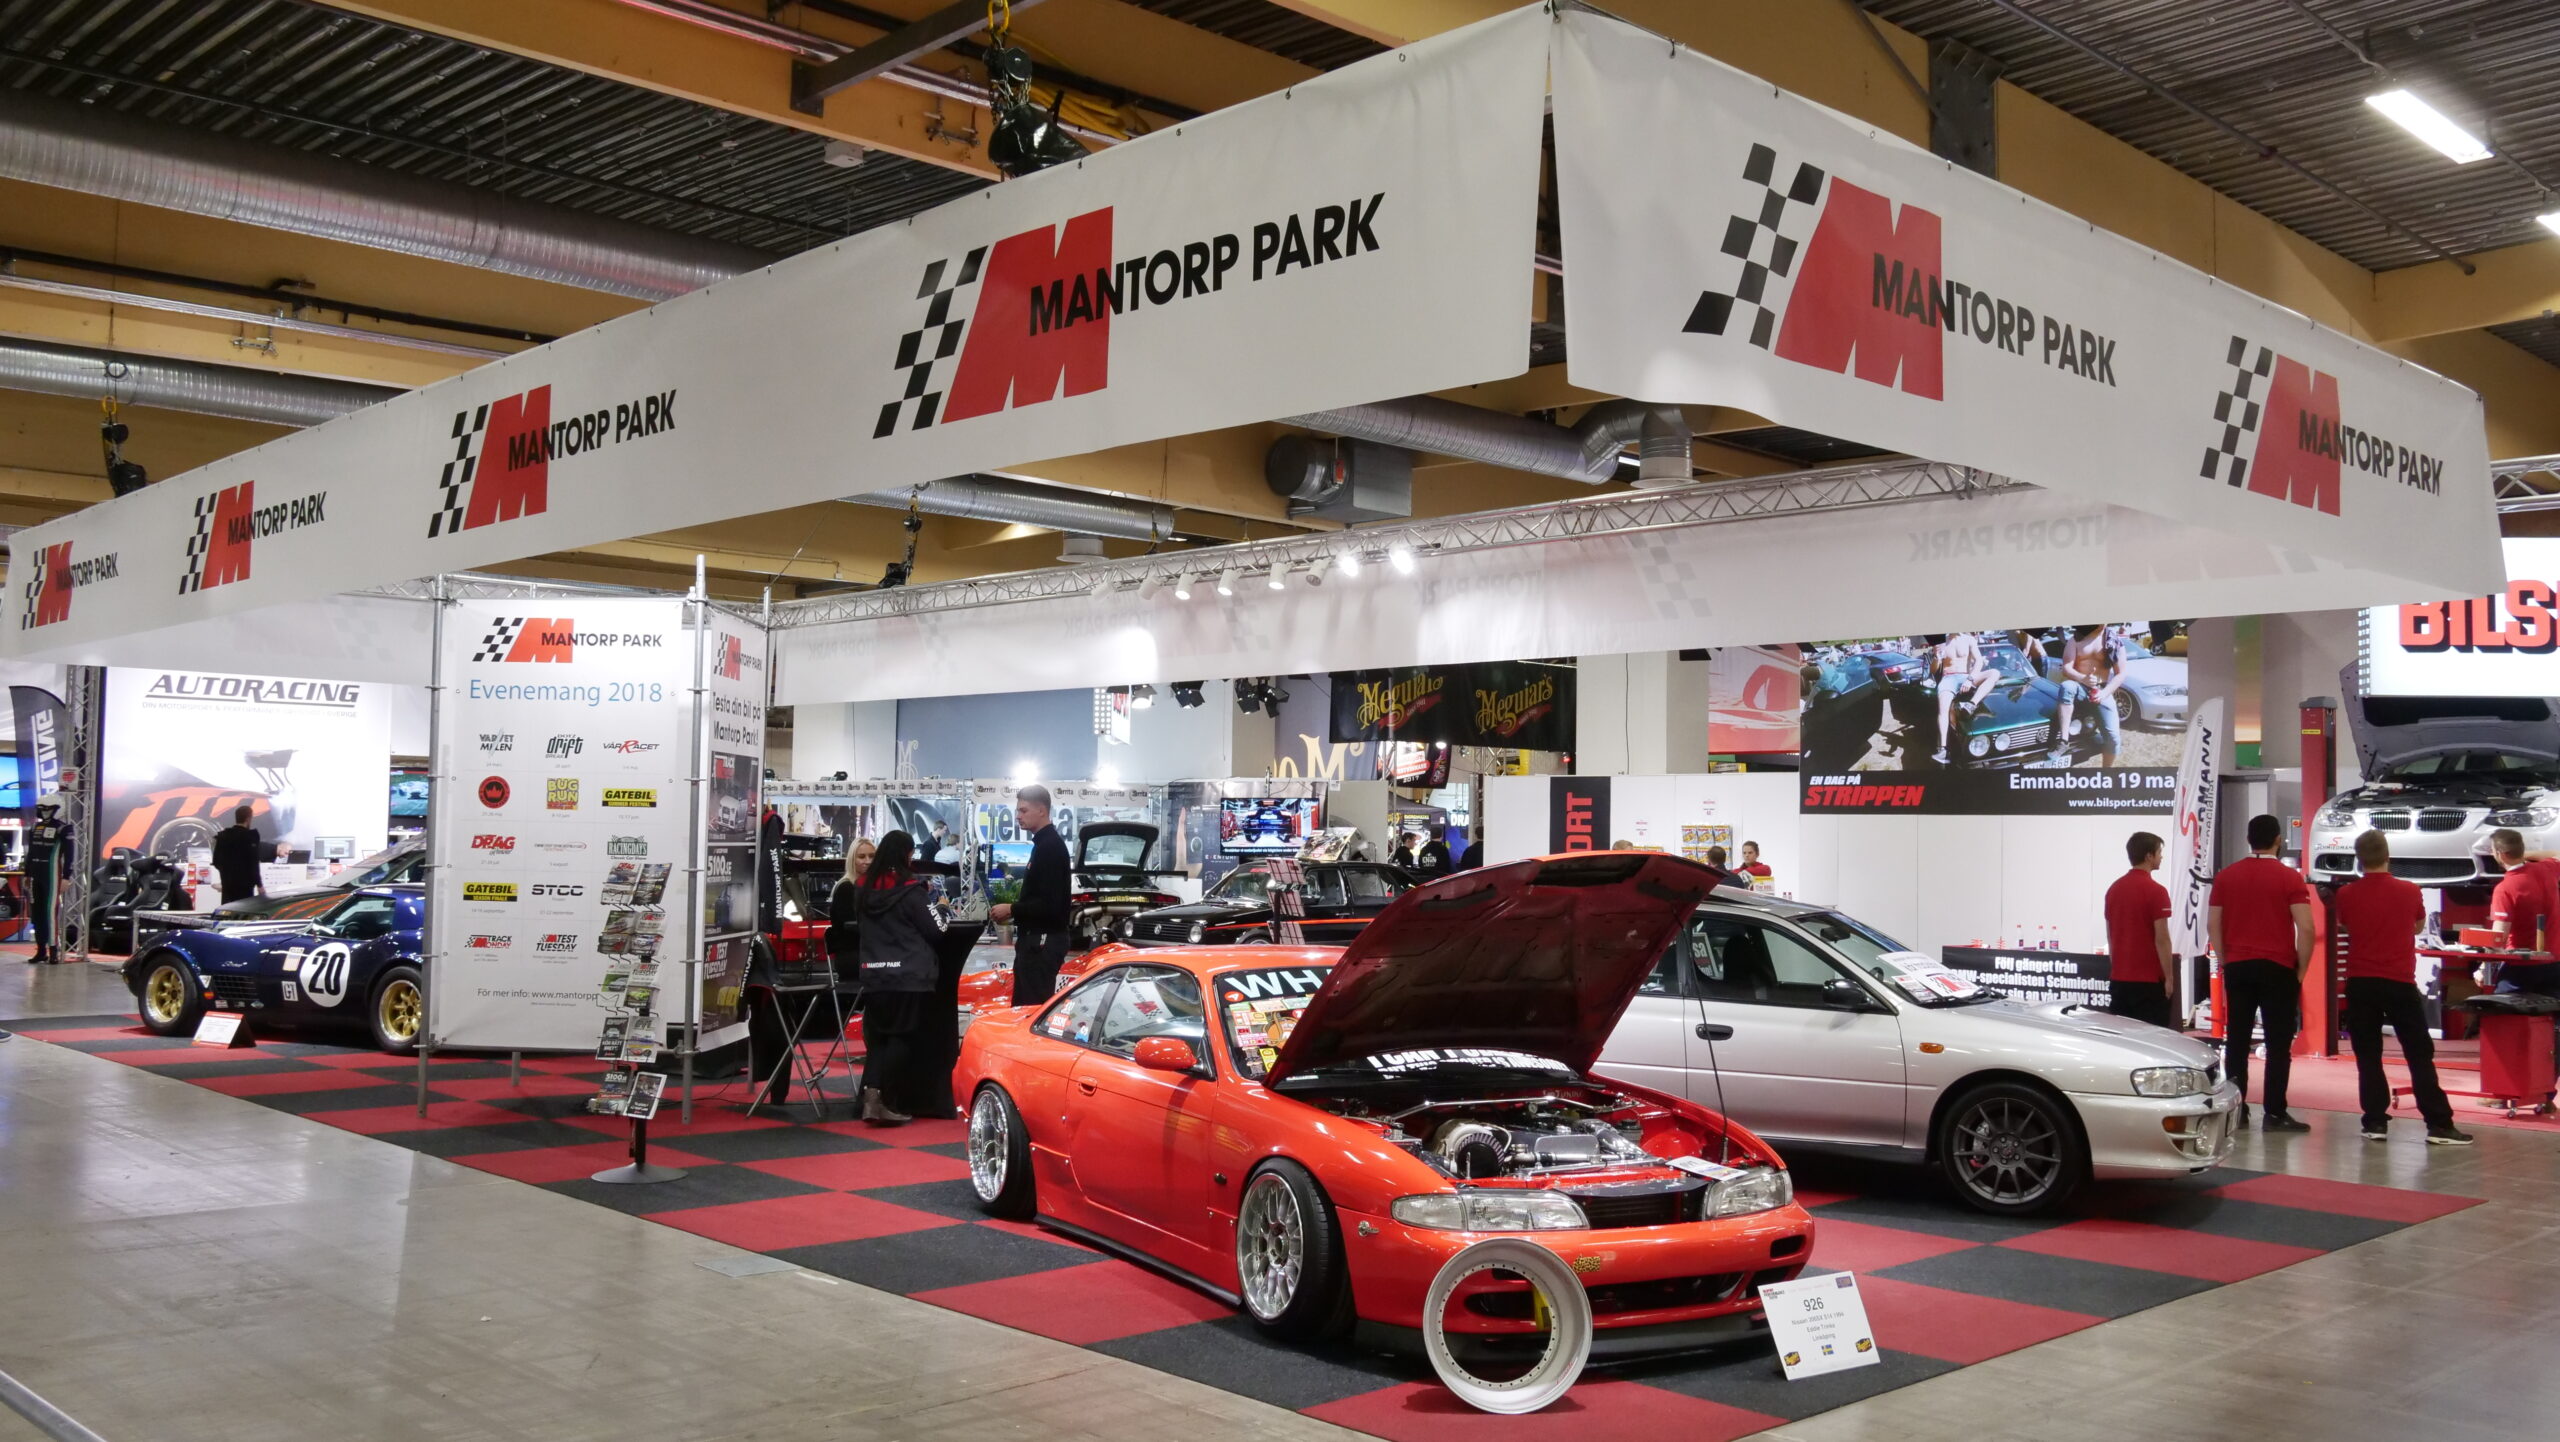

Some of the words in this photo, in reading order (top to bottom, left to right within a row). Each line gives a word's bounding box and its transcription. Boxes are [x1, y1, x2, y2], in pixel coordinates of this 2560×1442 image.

[1029, 233, 1239, 337] MANTORP
[1253, 191, 1385, 282] PARK
[1872, 252, 2035, 357] MANTORP
[2043, 315, 2117, 388] PARK
[508, 409, 610, 472] MANTORP
[616, 389, 677, 444] PARK
[2300, 409, 2394, 478] MANTORP
[2398, 445, 2443, 497] PARK
[227, 506, 287, 545] MANTORP
[291, 491, 327, 527] PARK
[95, 552, 118, 580] PARK
[2399, 580, 2560, 655] BILS
[541, 632, 618, 647] MANTORP
[622, 634, 663, 648] PARK
[149, 674, 360, 703] AUTORACING
[470, 679, 600, 706] Evenemang
[608, 683, 662, 702] 2018
[713, 692, 730, 712] Testa
[732, 698, 742, 714] din
[743, 700, 752, 718] bil
[752, 704, 761, 722] på
[1475, 672, 1553, 735] Meguiar's
[713, 721, 741, 747] Mantorp
[547, 778, 579, 791] BUG
[1810, 776, 1823, 786] EN
[1823, 776, 1845, 785] DAG
[1846, 773, 1861, 786] PÅ
[2009, 772, 2112, 790] Emmaboda
[2118, 772, 2141, 789] 19
[547, 791, 579, 802] RUN
[605, 790, 652, 799] GATEBIL
[1805, 785, 1925, 807] STRIPPEN
[1565, 792, 1592, 852] ORT
[471, 834, 516, 850] DRAG
[770, 848, 781, 873] PARK
[466, 884, 513, 893] GATEBIL
[531, 884, 583, 896] STCC
[557, 935, 578, 943] TEST
[308, 950, 346, 996] 20
[1995, 957, 2014, 972] Följ
[2015, 958, 2053, 974] gänget
[2055, 960, 2078, 974] från
[477, 988, 491, 997] För
[493, 990, 509, 998] mer
[531, 991, 598, 1000] www.mantorpp
[1224, 969, 1332, 998] WH
[2047, 976, 2111, 991] Schmiedma
[2090, 994, 2112, 1007] 335
[1803, 1297, 1824, 1311] 926
